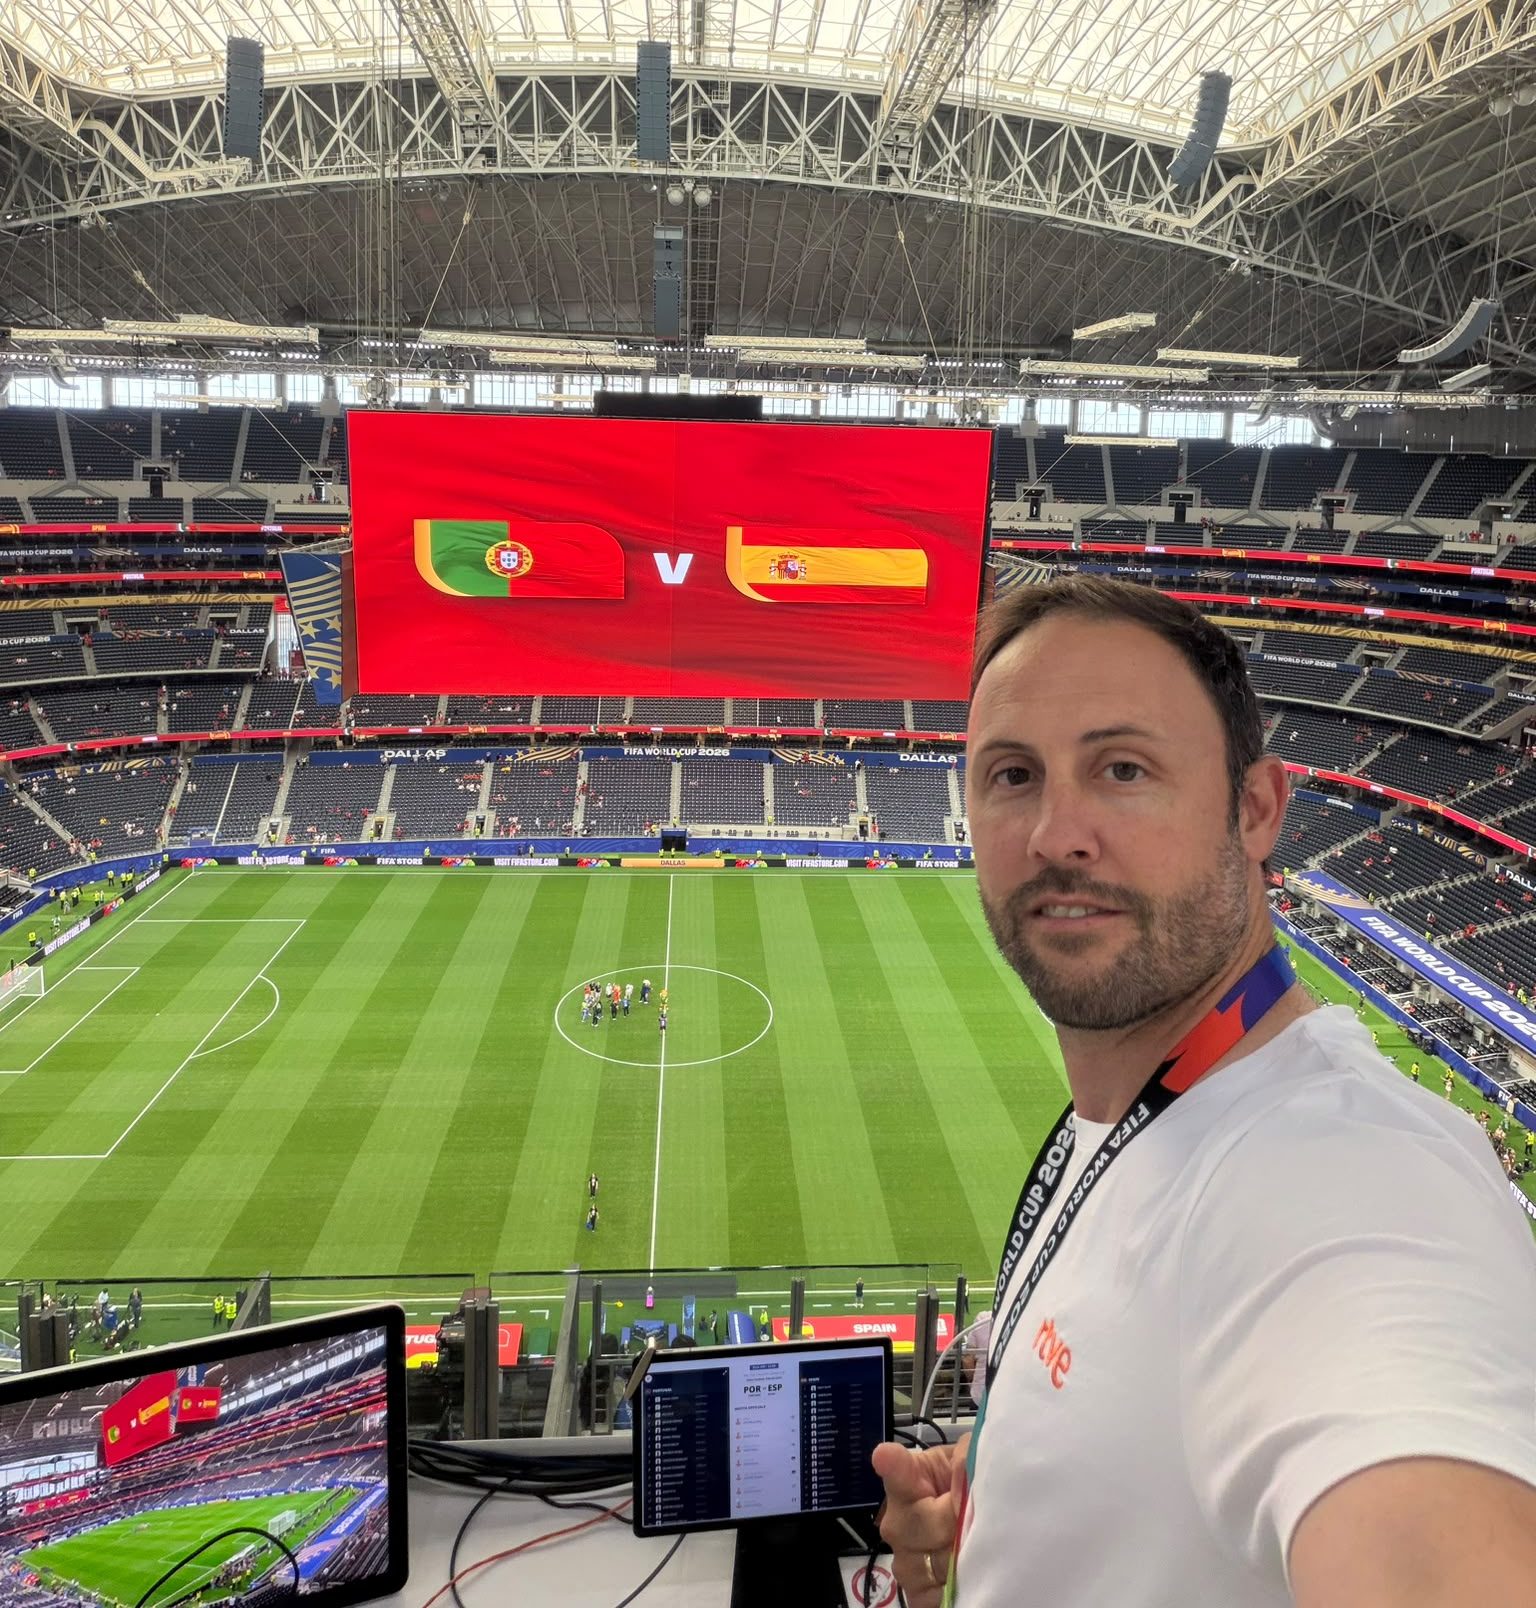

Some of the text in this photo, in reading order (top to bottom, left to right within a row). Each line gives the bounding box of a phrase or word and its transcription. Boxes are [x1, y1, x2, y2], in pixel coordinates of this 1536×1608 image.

[1420, 587, 1459, 596] DALLAS
[25, 636, 50, 644] 2026
[1264, 653, 1337, 668] FIFA WORLD CUP 2026
[1507, 692, 1536, 701] DALLAS
[384, 749, 446, 758] DALLAS
[680, 748, 697, 756] CUP
[698, 748, 730, 756] 2026
[900, 754, 958, 763] DALLAS
[238, 856, 255, 865] VISIT
[377, 857, 422, 865] FIFA STORE
[494, 858, 559, 866] VISIT FIFASTORE.COM
[786, 859, 848, 868] VISIT FIFASTORE.COM
[1359, 916, 1536, 1042] FIFA WORLD CUP 202
[1108, 1103, 1150, 1149] FIFA
[1057, 1151, 1110, 1233] WORLD
[1019, 1184, 1045, 1231] CUP
[1031, 1234, 1057, 1284] CUP
[853, 1323, 897, 1333] SPAIN
[405, 1334, 437, 1345] TUG
[1032, 1317, 1072, 1390] rtve
[743, 1385, 761, 1394] POR
[767, 1383, 783, 1392] ESP
